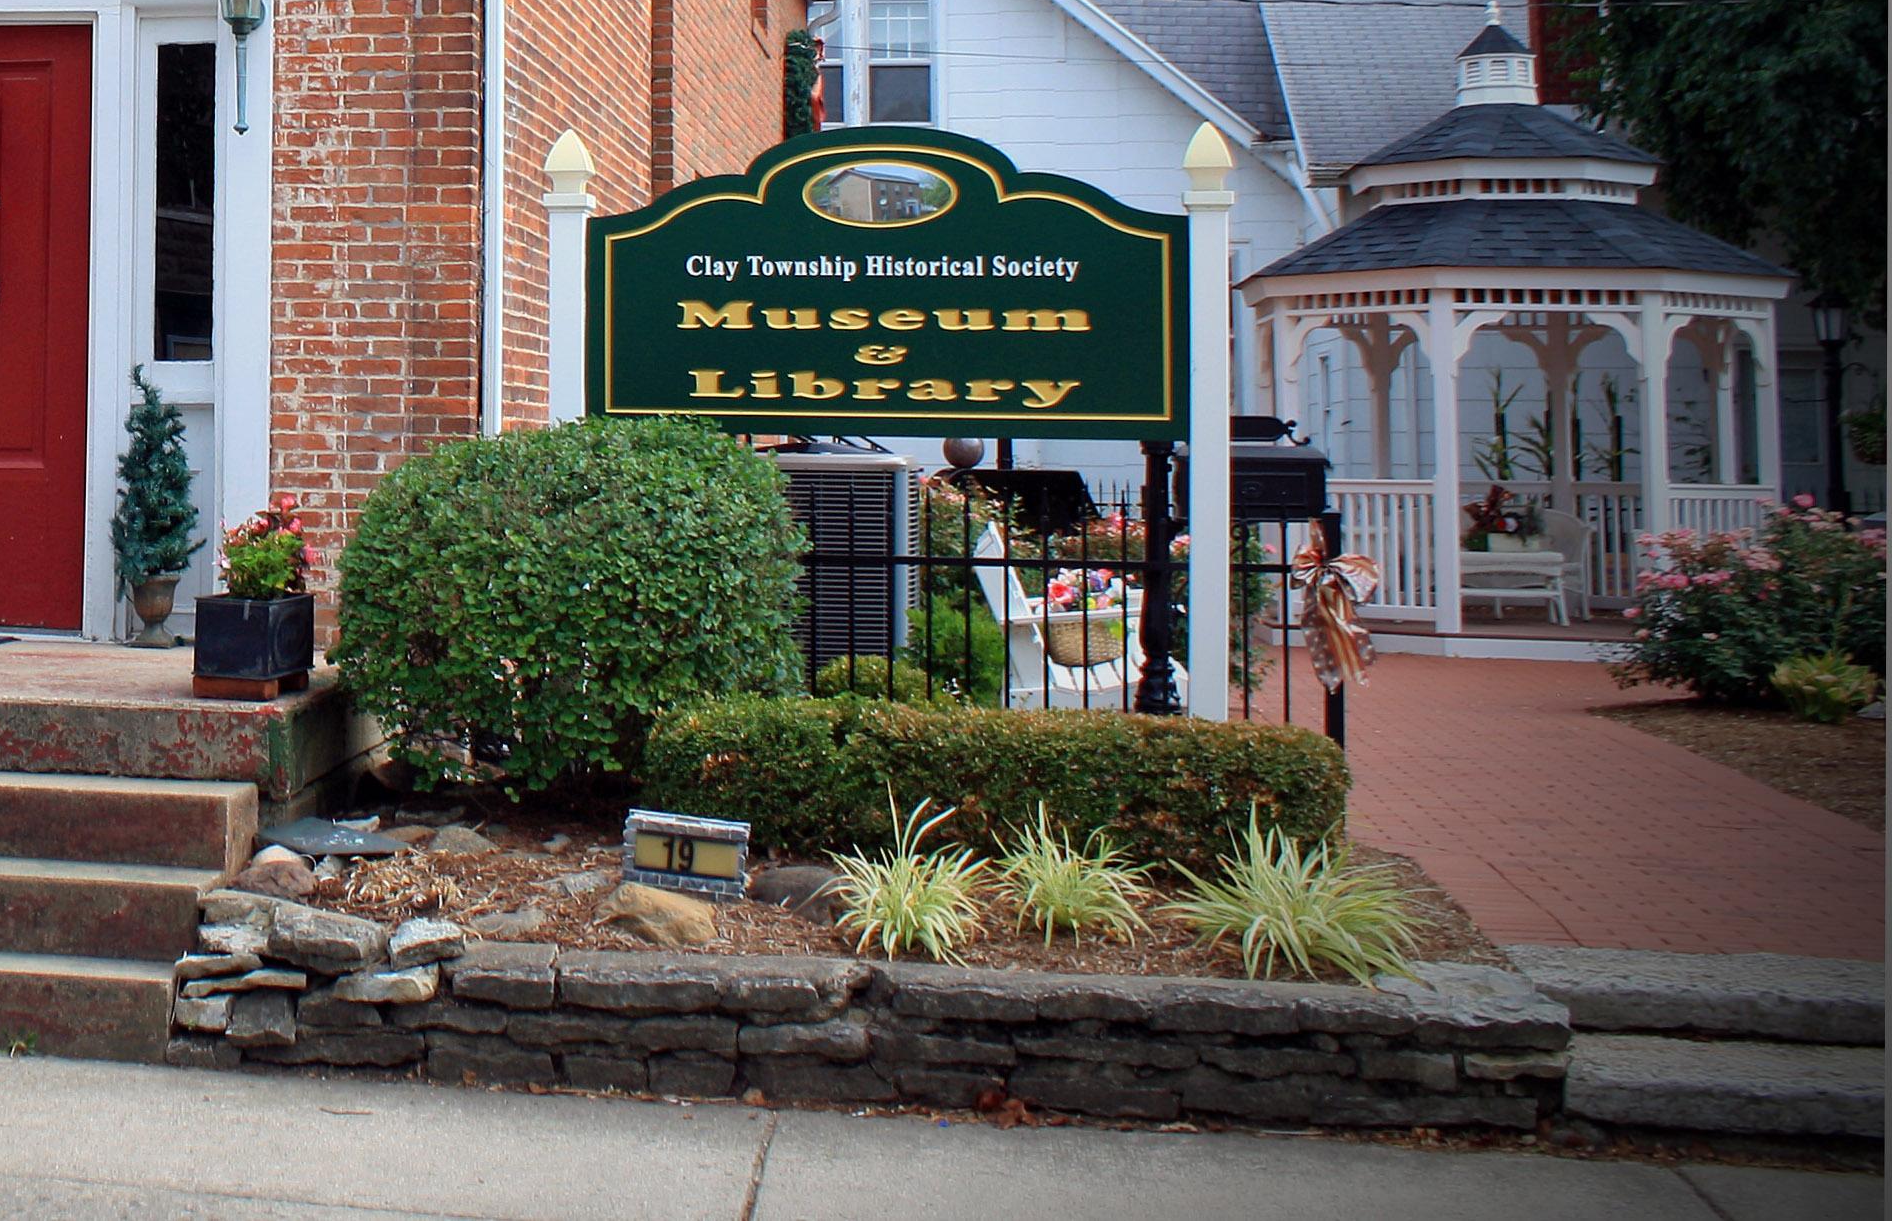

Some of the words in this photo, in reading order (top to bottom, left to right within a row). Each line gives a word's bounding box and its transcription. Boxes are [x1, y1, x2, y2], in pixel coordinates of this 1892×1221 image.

[685, 255, 739, 281] Clay
[746, 255, 858, 282] Township
[864, 254, 984, 278] Historical
[991, 255, 1079, 282] Society
[676, 299, 1092, 332] Museum
[853, 343, 909, 365] &
[687, 368, 1082, 409] Library
[662, 837, 695, 872] 19
